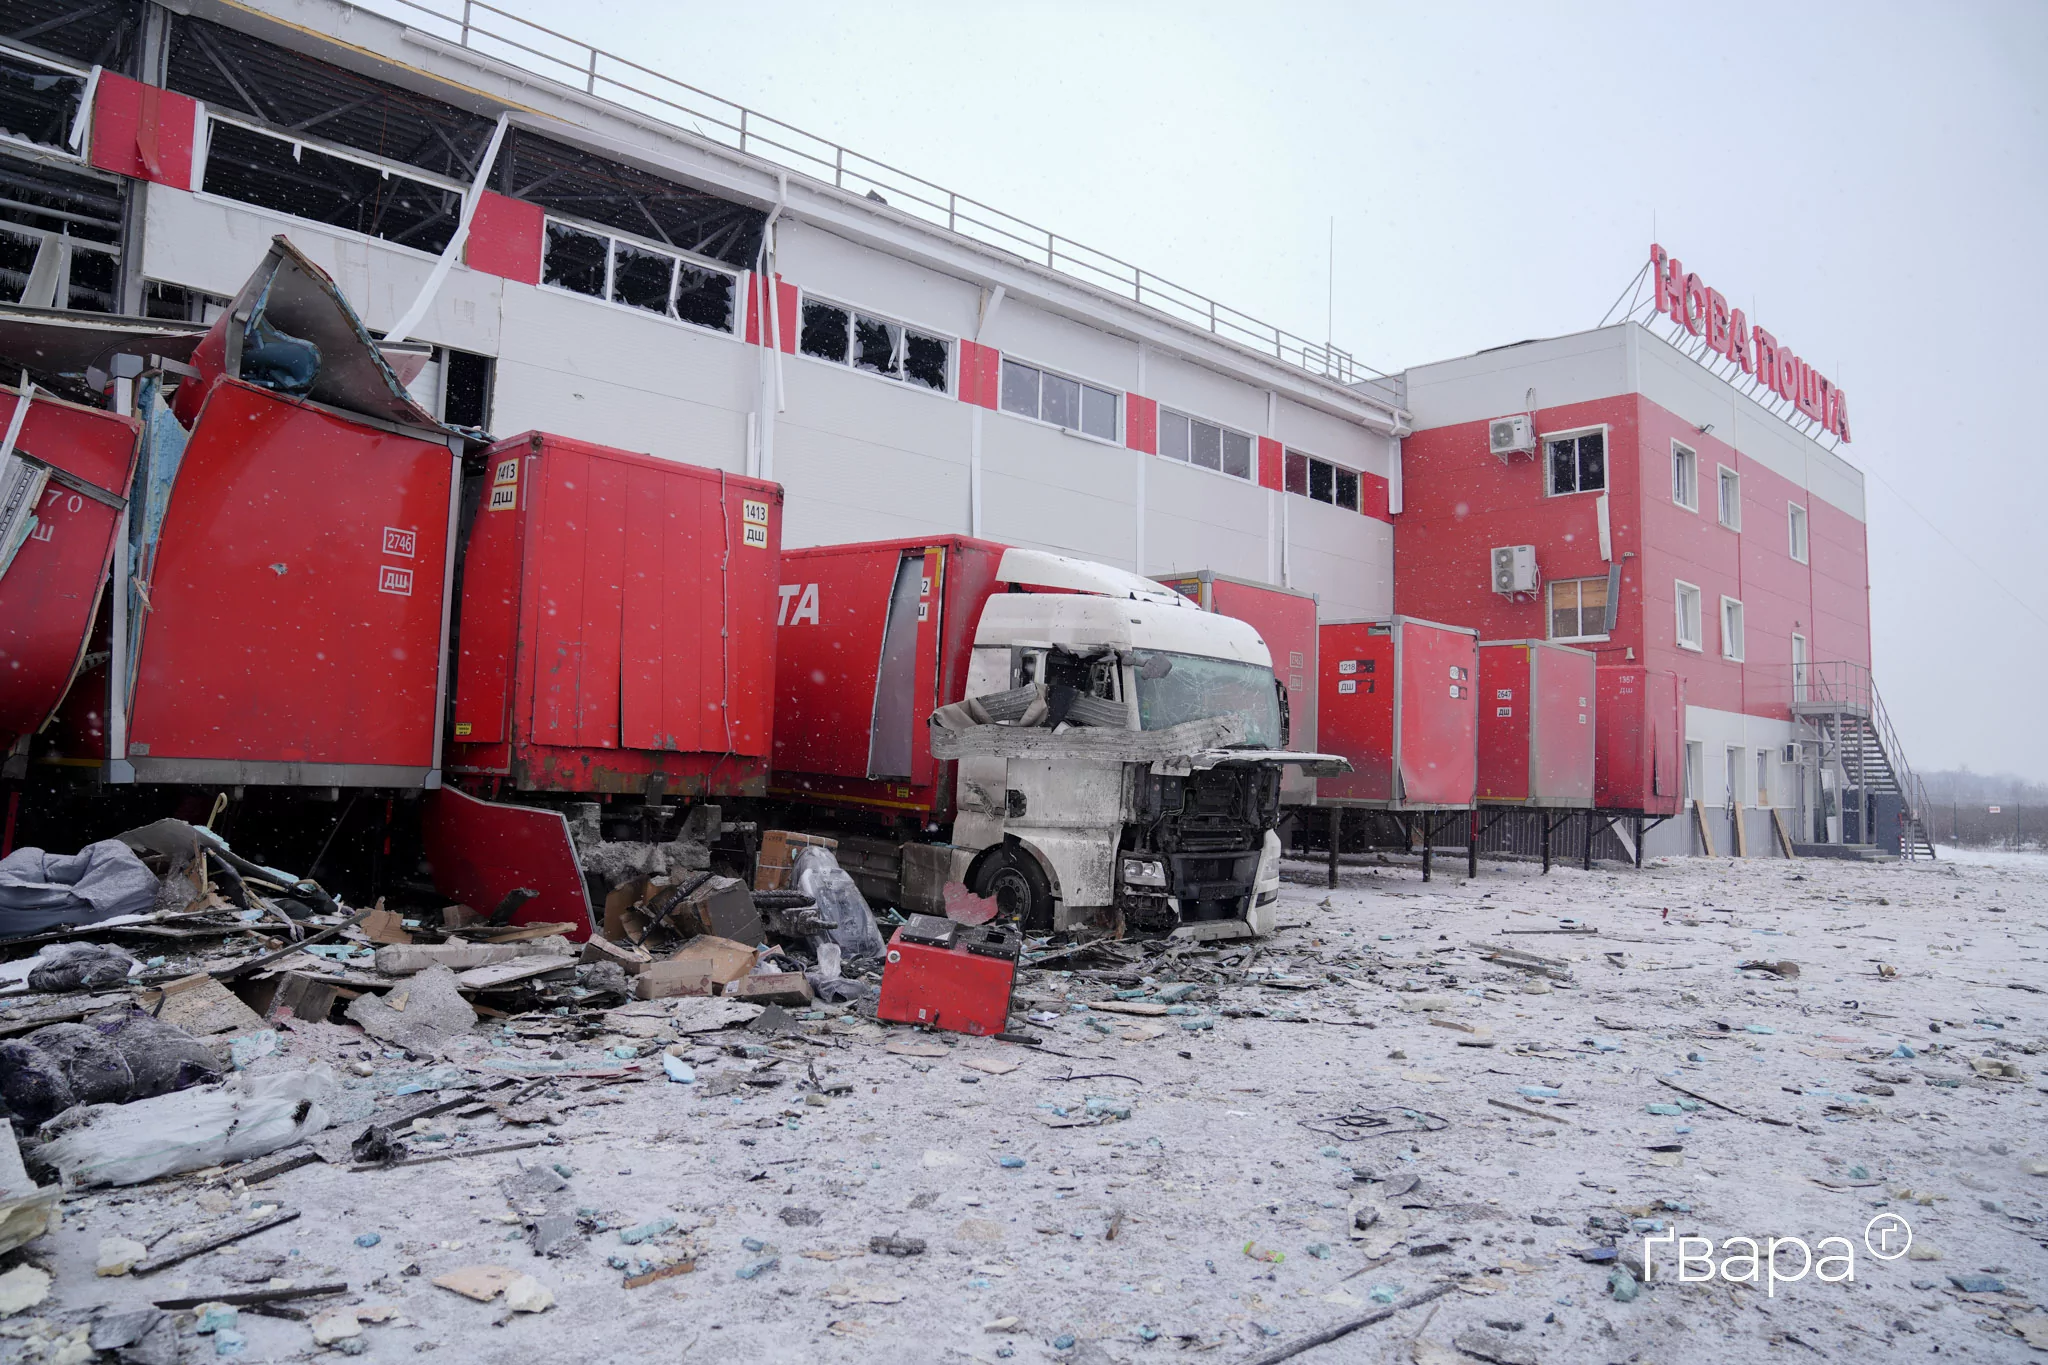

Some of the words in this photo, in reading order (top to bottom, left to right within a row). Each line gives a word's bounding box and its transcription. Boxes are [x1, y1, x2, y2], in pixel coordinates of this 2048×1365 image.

[1650, 243, 1753, 374] НОВА
[1753, 325, 1852, 443] ПОШТА
[497, 463, 516, 480] 1413
[492, 491, 513, 506] ДШ
[745, 504, 766, 521] 1413
[387, 533, 412, 552] 2746
[746, 528, 765, 542] ДШ
[384, 572, 408, 589] ДШ
[1340, 663, 1356, 671] 1218
[1341, 682, 1354, 691] ДШ
